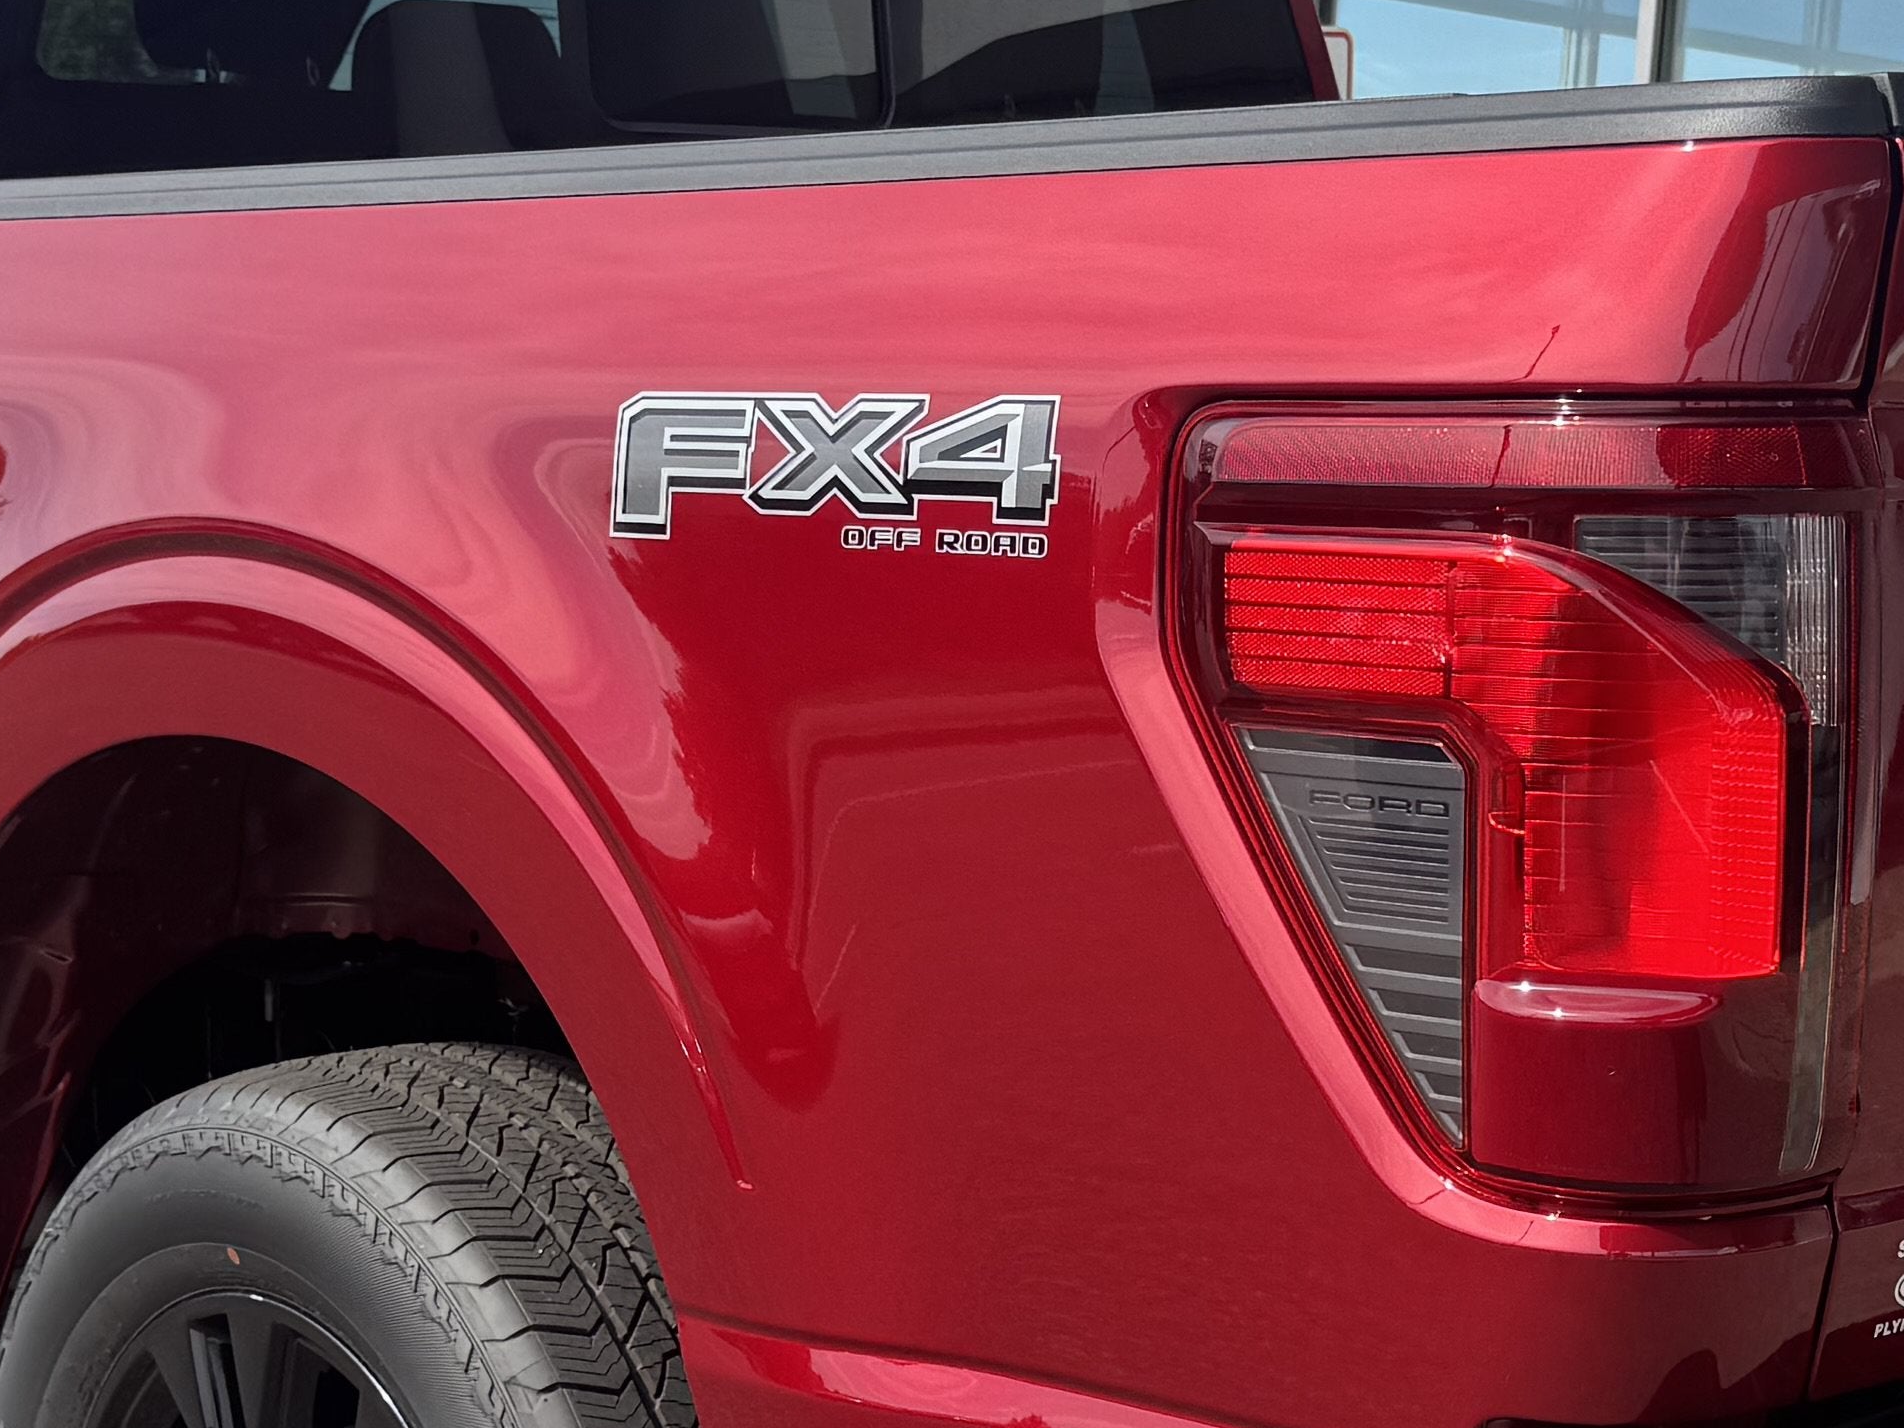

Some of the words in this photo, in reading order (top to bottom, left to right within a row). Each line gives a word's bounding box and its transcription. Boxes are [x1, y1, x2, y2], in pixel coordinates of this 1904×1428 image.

[609, 390, 1061, 539] FX4
[841, 525, 921, 552] OFF
[935, 529, 1049, 559] ROAD
[1308, 789, 1450, 819] FORD
